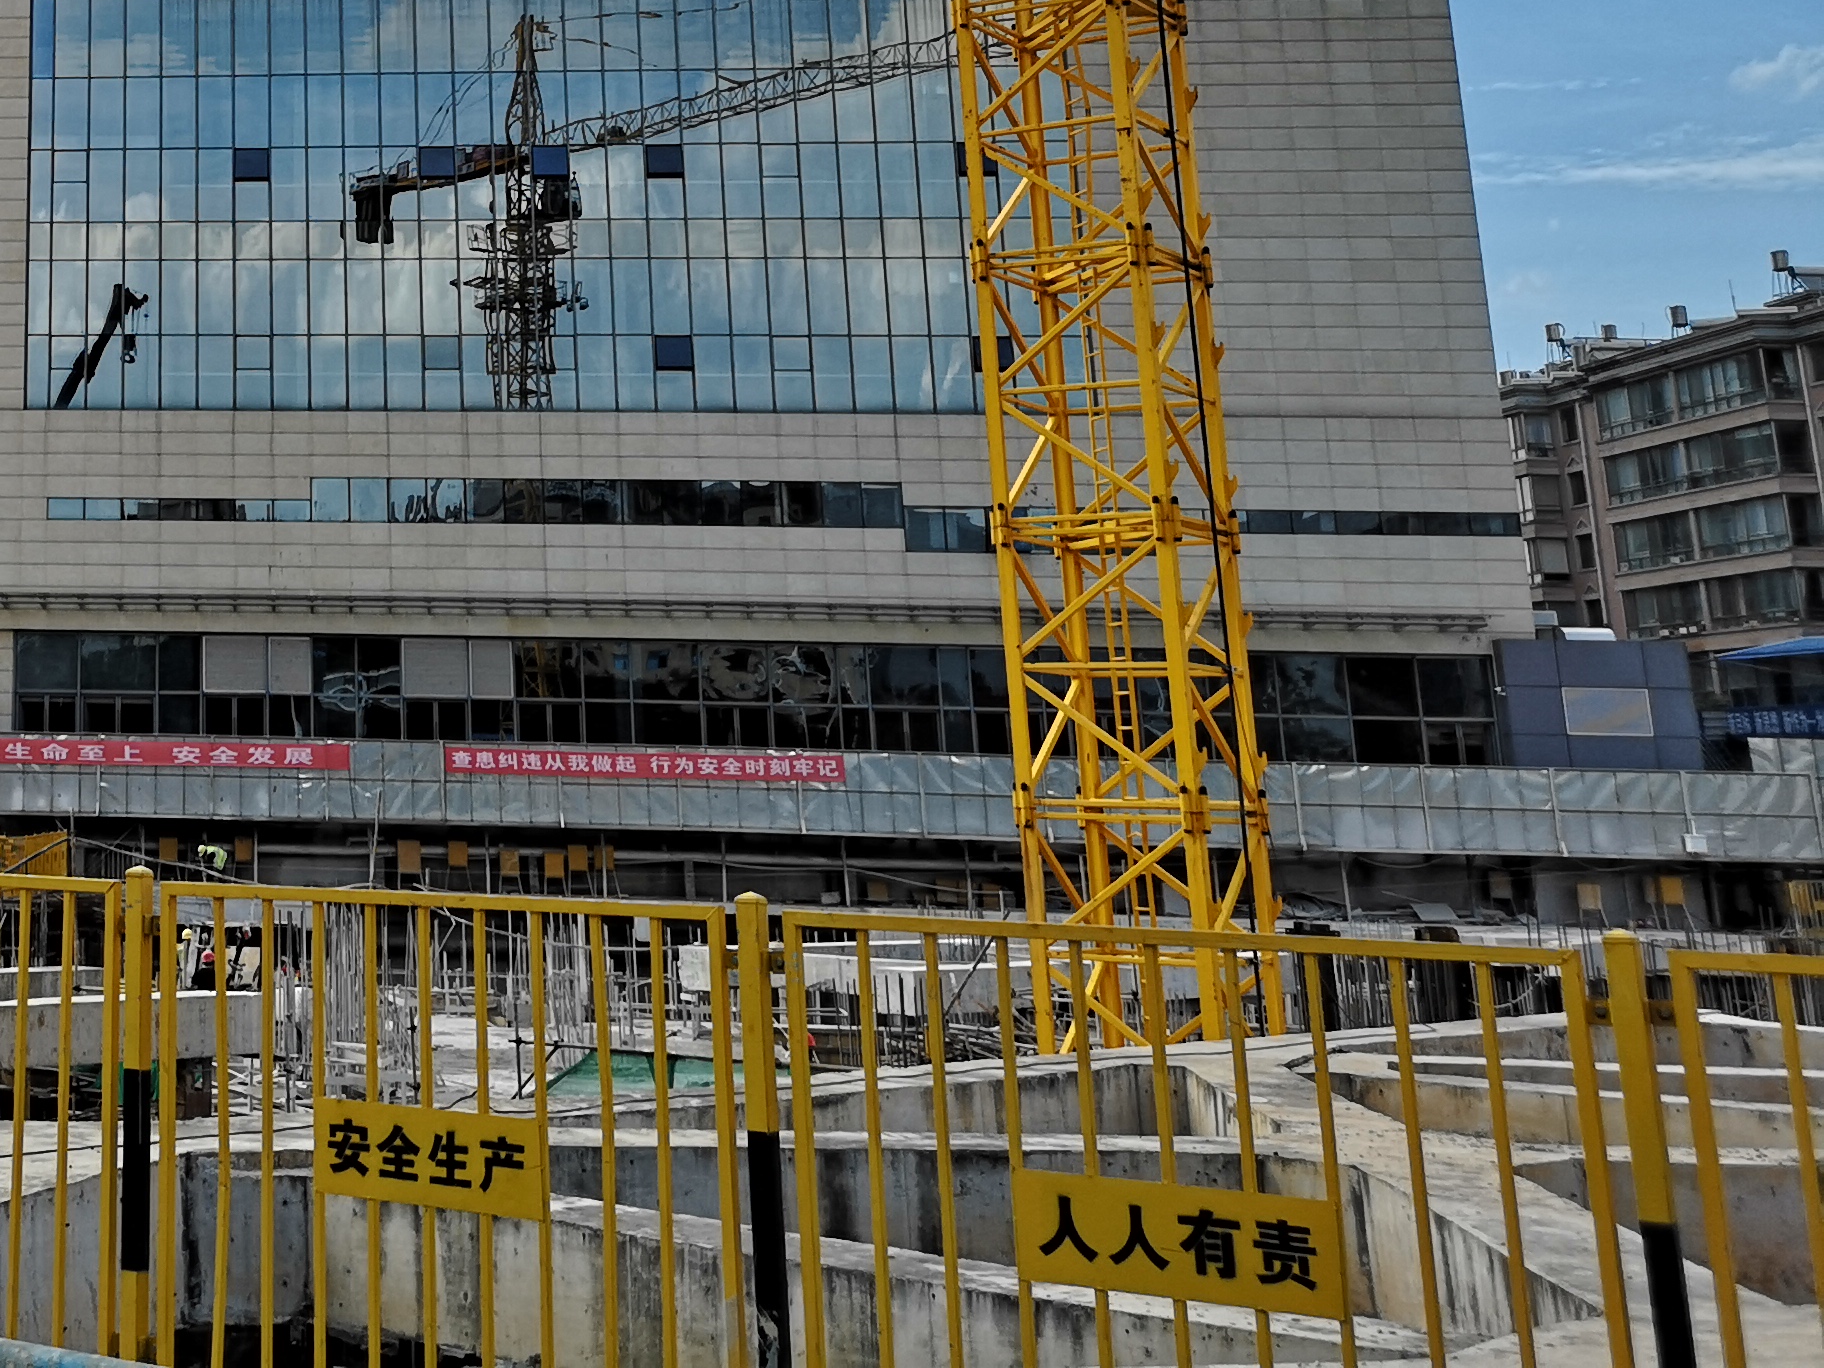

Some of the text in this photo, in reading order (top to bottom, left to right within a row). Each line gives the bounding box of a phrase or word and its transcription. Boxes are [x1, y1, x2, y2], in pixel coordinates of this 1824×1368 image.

[5, 742, 314, 766] 生命至上 安全发展
[451, 749, 840, 779] 查患纠违从我做起 行为安全时刻牢记
[327, 1118, 525, 1192] 安全生产
[1039, 1195, 1318, 1292] 人人有责
